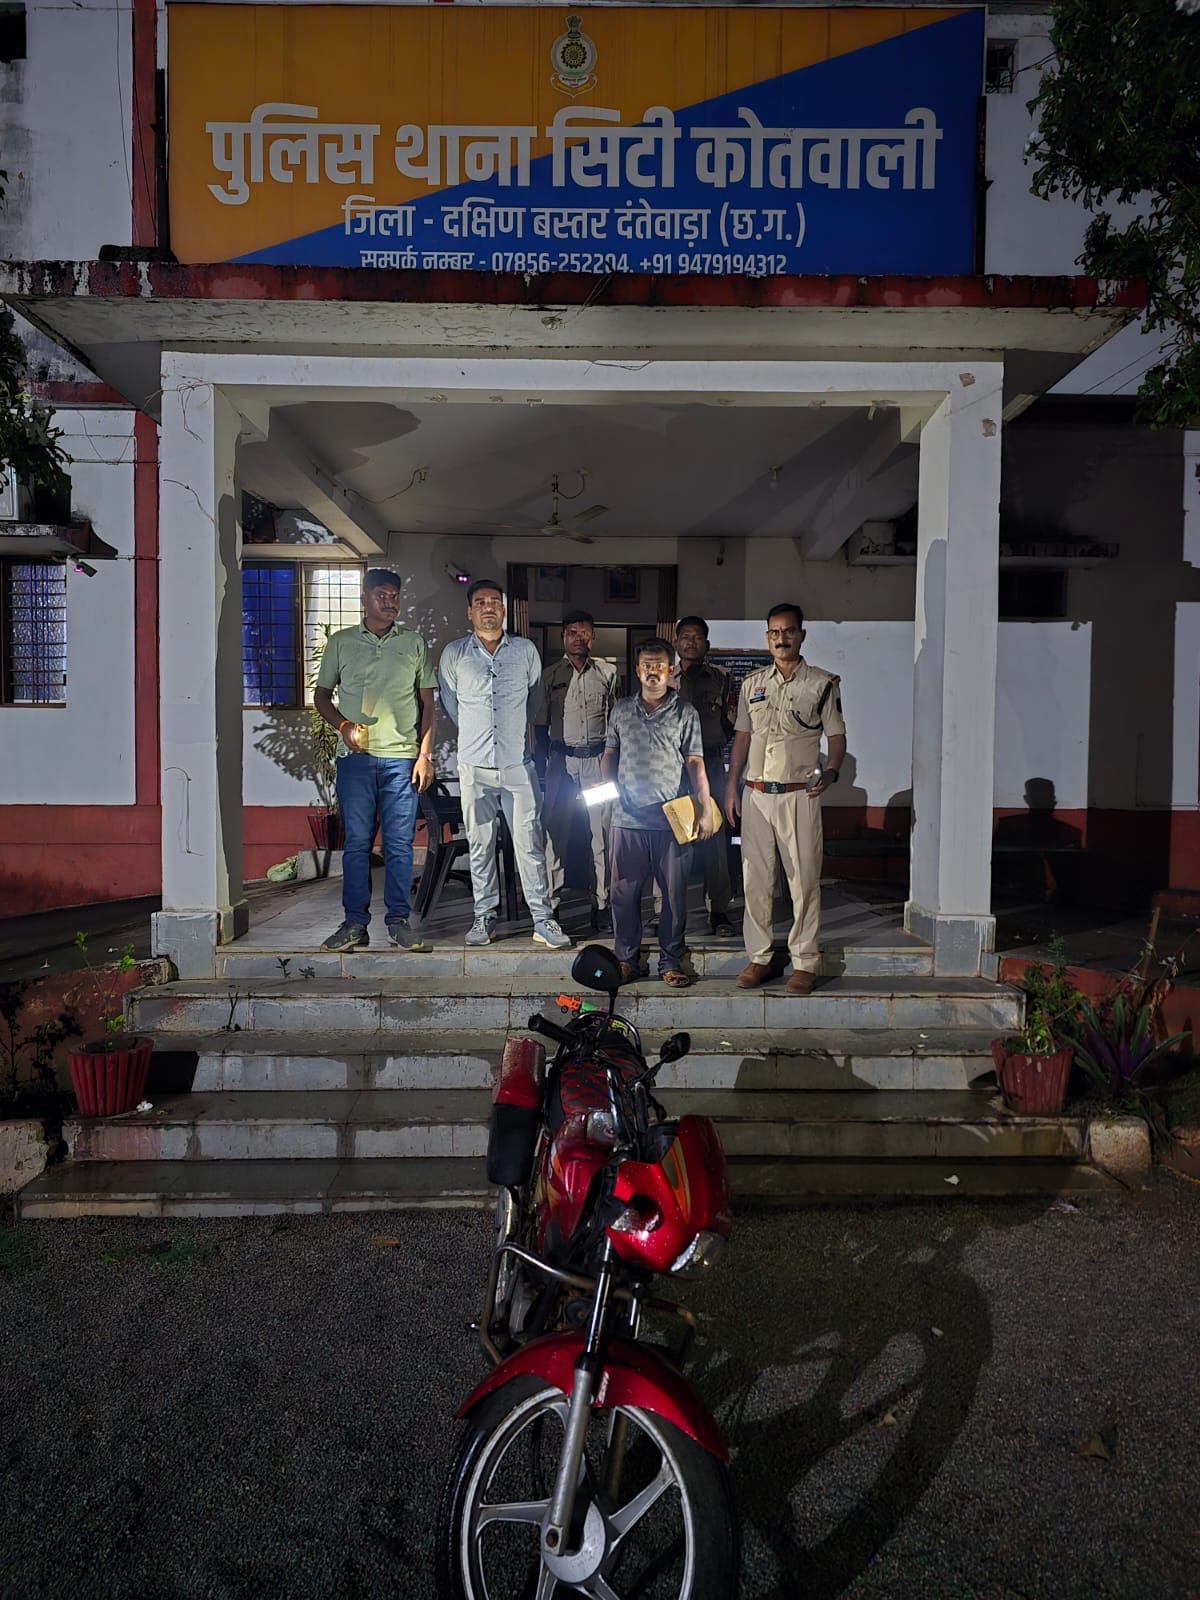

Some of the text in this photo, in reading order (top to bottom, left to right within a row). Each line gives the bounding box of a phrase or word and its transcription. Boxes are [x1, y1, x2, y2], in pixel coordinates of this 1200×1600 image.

[205, 103, 943, 205] पुलिस थाना सिटी कोतवाली
[341, 195, 416, 237] जिला
[441, 196, 526, 239] दक्षिण
[530, 207, 610, 240] बस्तर
[614, 198, 711, 248] दंतेवाड़ा
[719, 201, 806, 248] (छ.ग.)
[360, 245, 418, 269] सम्पर्क
[421, 252, 475, 270] नम्बर
[640, 253, 672, 275] +91
[678, 253, 787, 275] 9479194312
